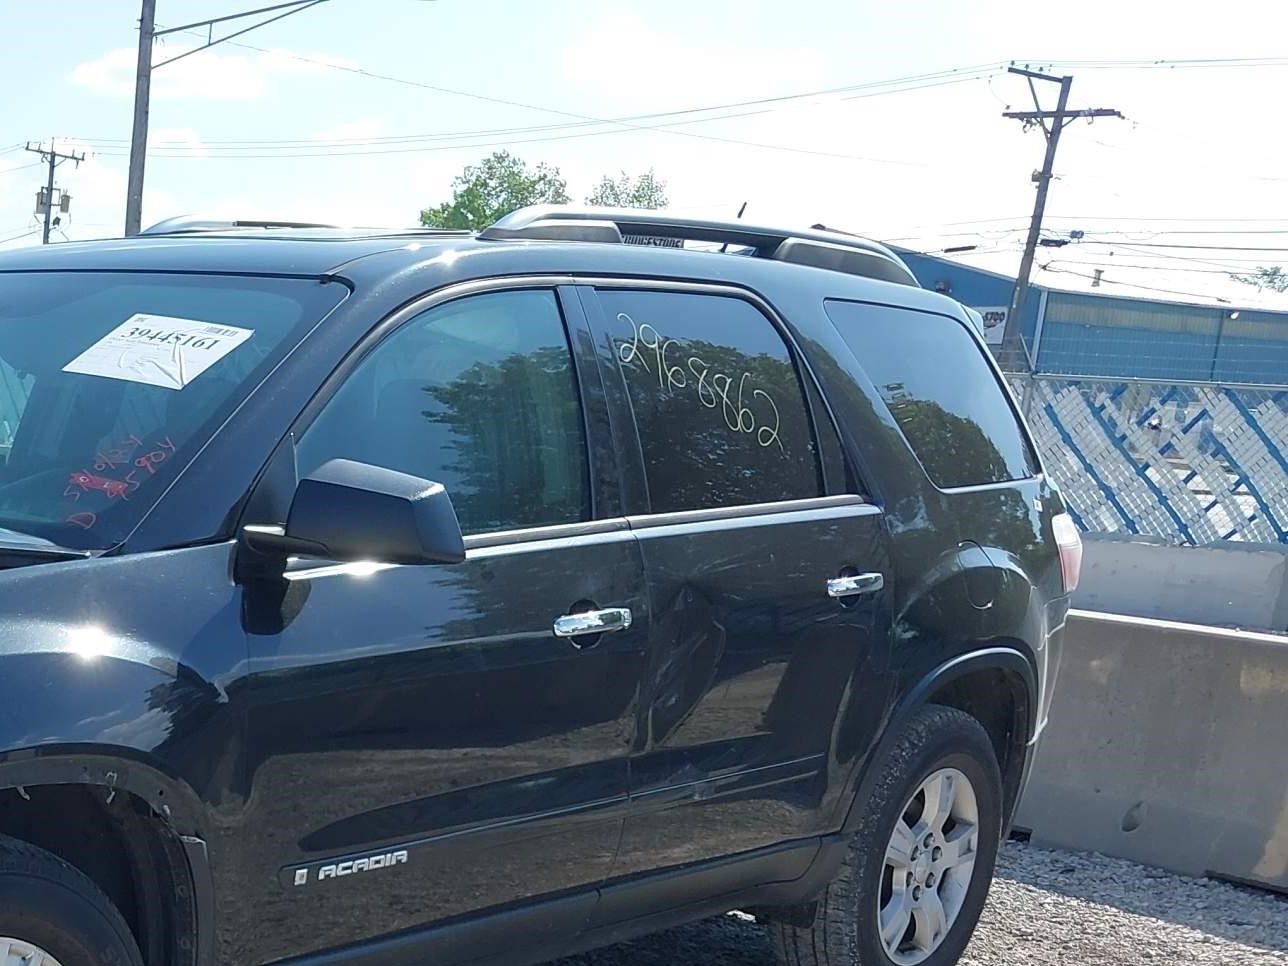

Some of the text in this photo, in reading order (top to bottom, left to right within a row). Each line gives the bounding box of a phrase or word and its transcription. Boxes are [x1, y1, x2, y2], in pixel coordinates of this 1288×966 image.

[121, 327, 221, 351] 39445161
[616, 312, 785, 456] 2968862
[318, 850, 409, 881] ACADIA
